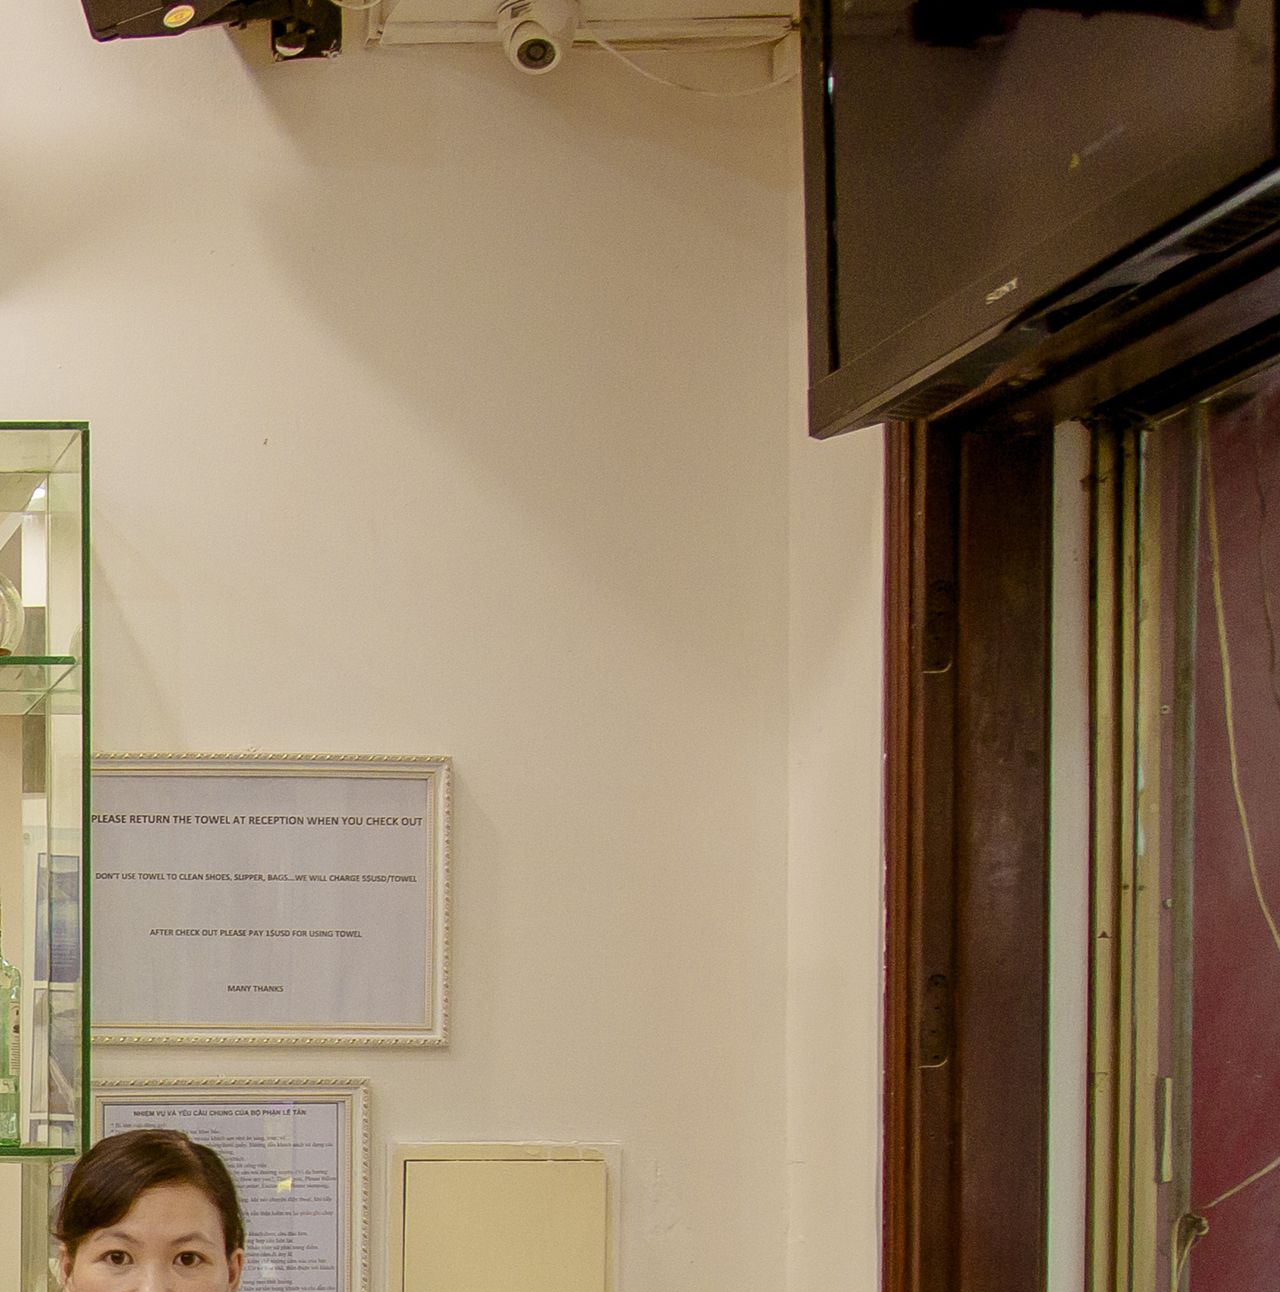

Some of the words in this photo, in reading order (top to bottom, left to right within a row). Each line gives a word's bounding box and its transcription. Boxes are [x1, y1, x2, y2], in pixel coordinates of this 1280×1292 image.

[91, 814, 127, 823] PLEASE
[130, 815, 170, 824] RETURN
[173, 815, 191, 824] THE
[195, 816, 230, 825] TOWEL
[233, 816, 245, 825] AT
[249, 816, 304, 825] RECEPTION
[307, 816, 338, 825] WHEN
[342, 817, 363, 826] YOU
[366, 817, 398, 826] CHECK
[401, 817, 423, 826] OUT
[149, 928, 174, 936] AFTER
[201, 929, 217, 937] OUT
[220, 929, 246, 937] PLEASE
[249, 929, 263, 937] PAY
[292, 930, 307, 938] FOR
[309, 930, 333, 938] USING
[335, 930, 362, 938] TOWEL
[253, 985, 284, 993] THANKS
